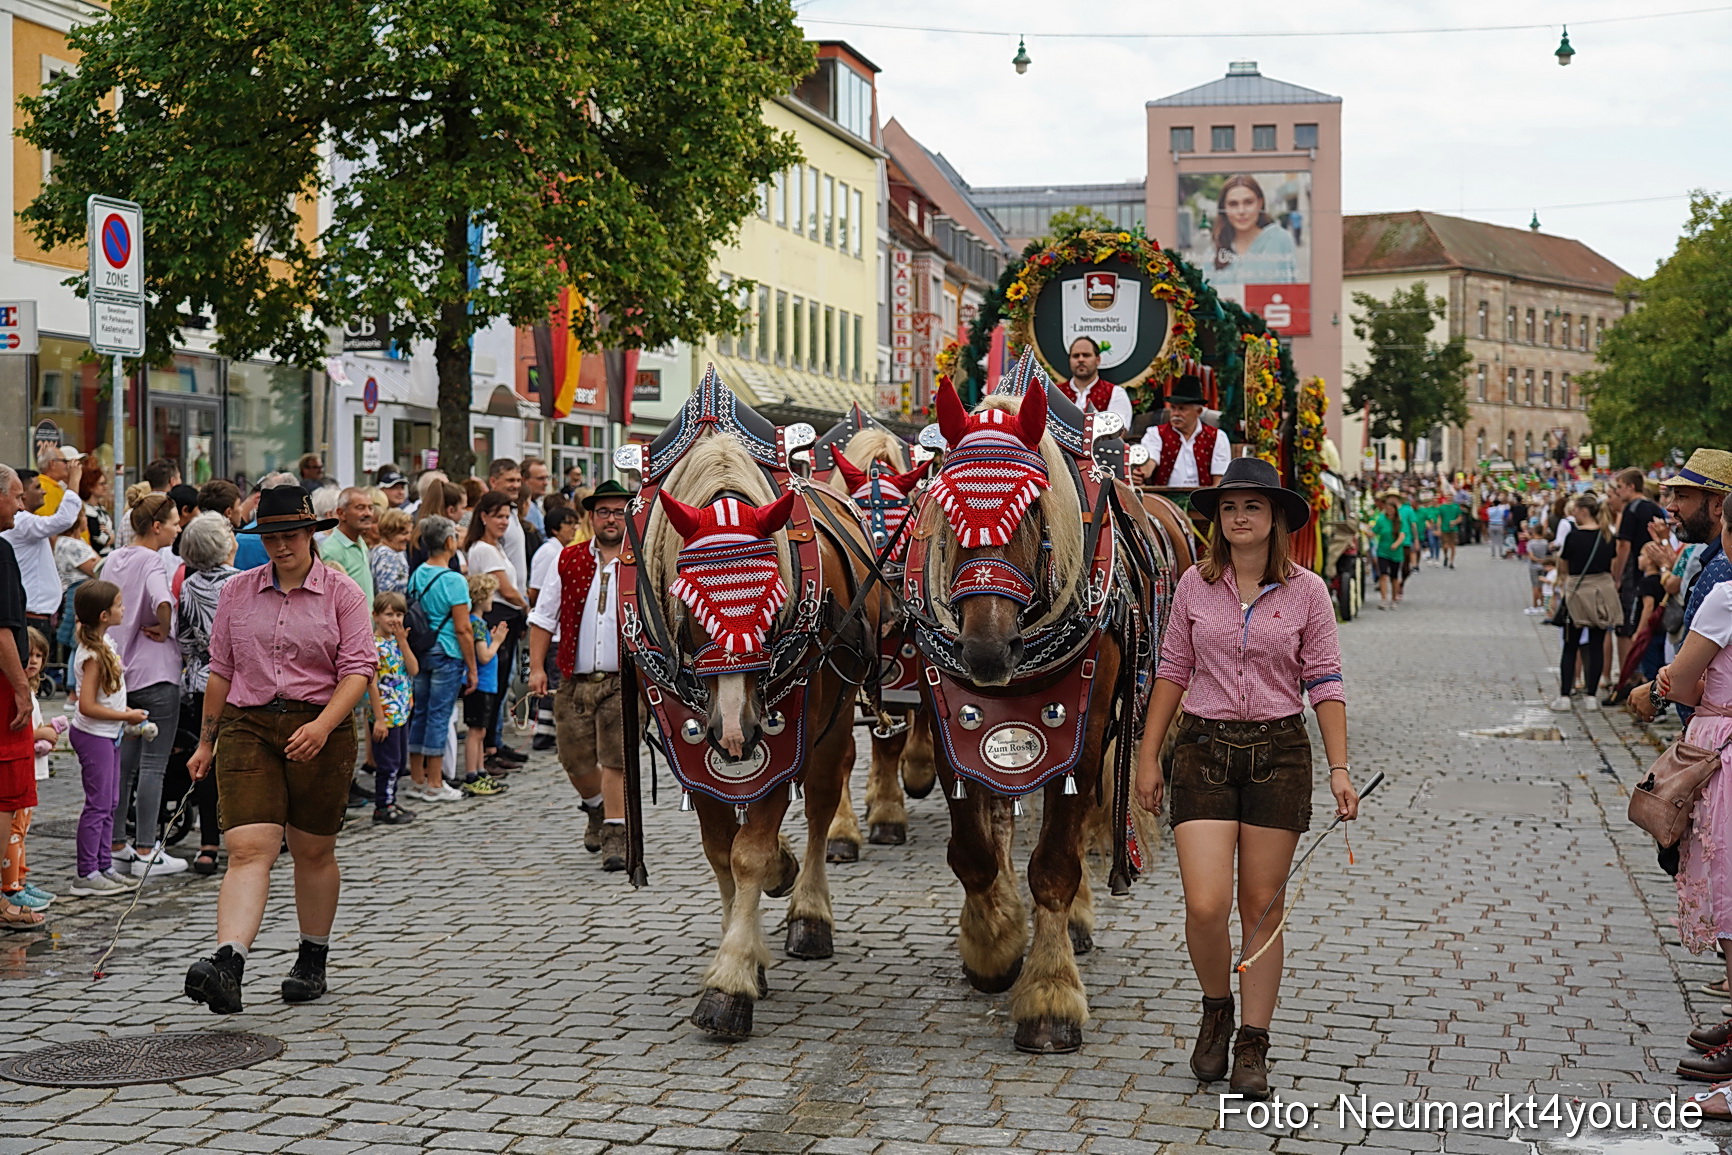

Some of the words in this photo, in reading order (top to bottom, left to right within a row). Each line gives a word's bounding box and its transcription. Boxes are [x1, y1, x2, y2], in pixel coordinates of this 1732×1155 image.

[106, 271, 129, 288] ZONE
[1080, 315, 1120, 323] Neumarkter
[1073, 323, 1127, 332] Lammsbräu
[113, 336, 123, 344] frei
[344, 339, 382, 348] arfümerie
[987, 744, 1008, 754] Zum
